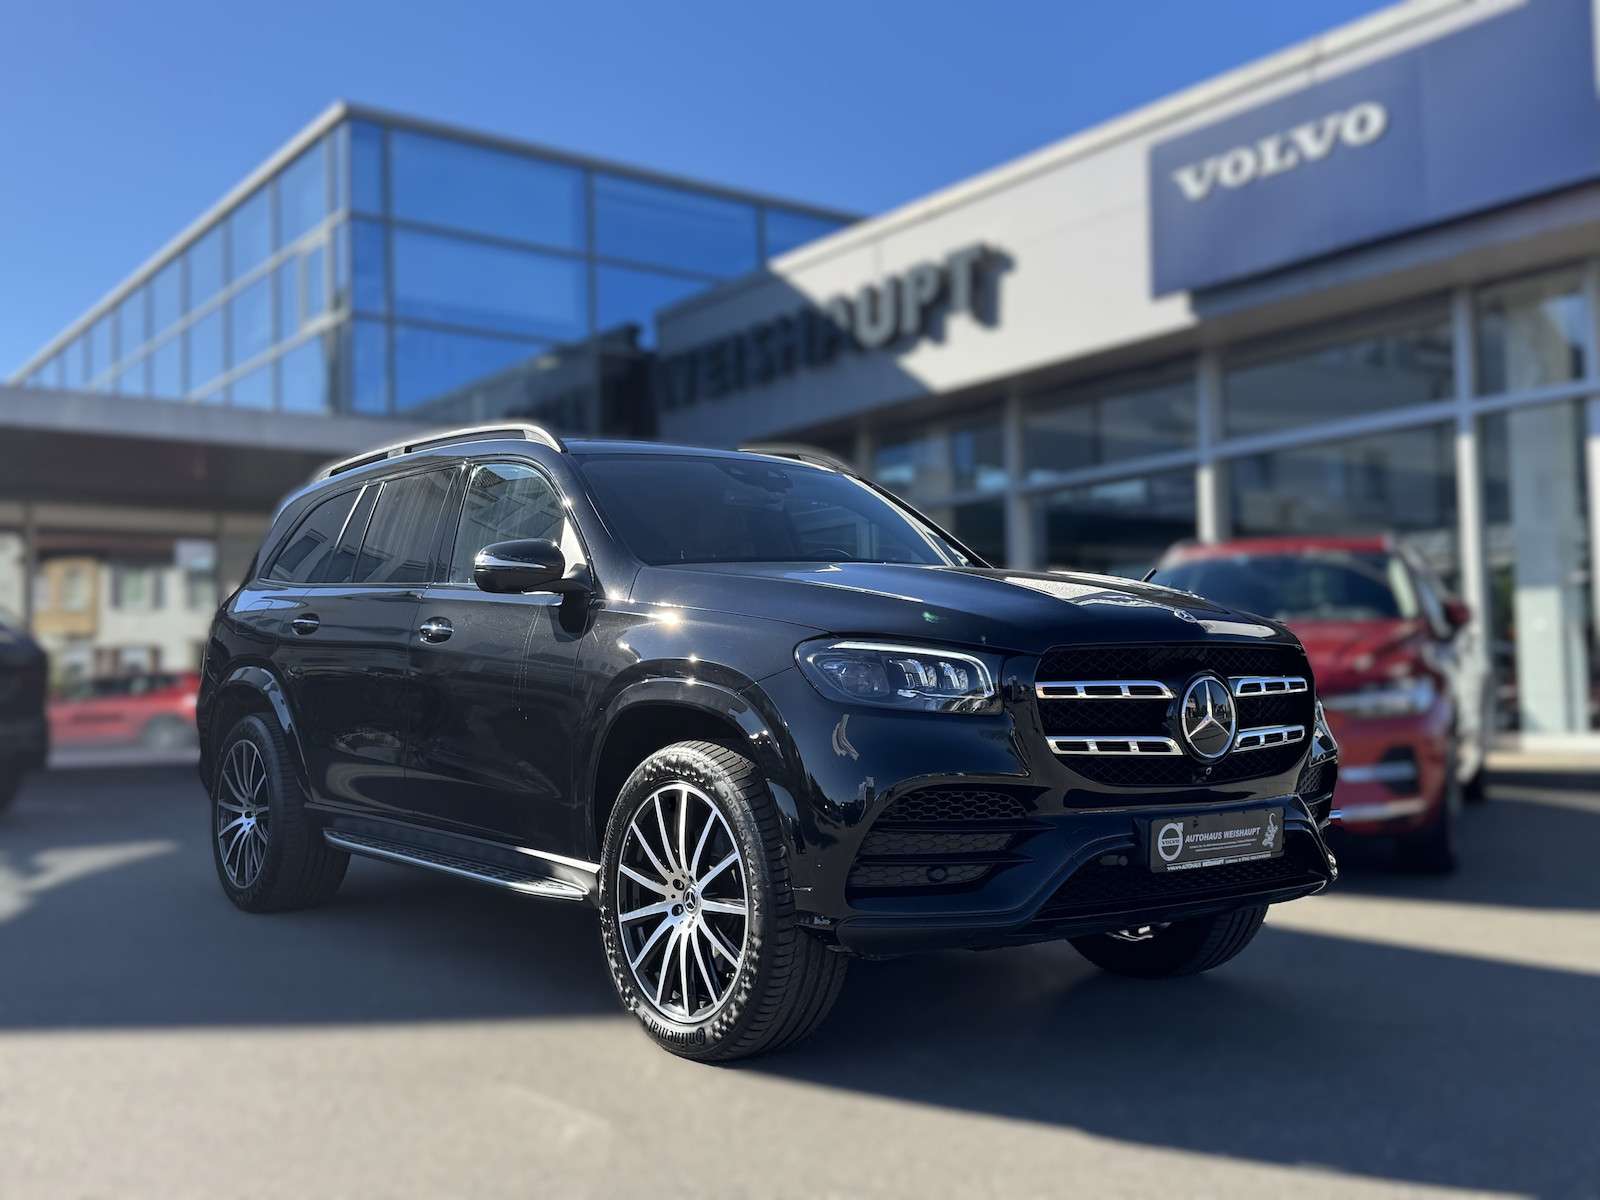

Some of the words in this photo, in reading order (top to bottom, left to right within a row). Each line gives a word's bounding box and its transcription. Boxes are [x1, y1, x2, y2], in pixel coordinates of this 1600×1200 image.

[1171, 101, 1388, 202] VOLVO
[1184, 832, 1223, 844] AUTOHAUS
[1223, 826, 1261, 839] WEISHAUPT
